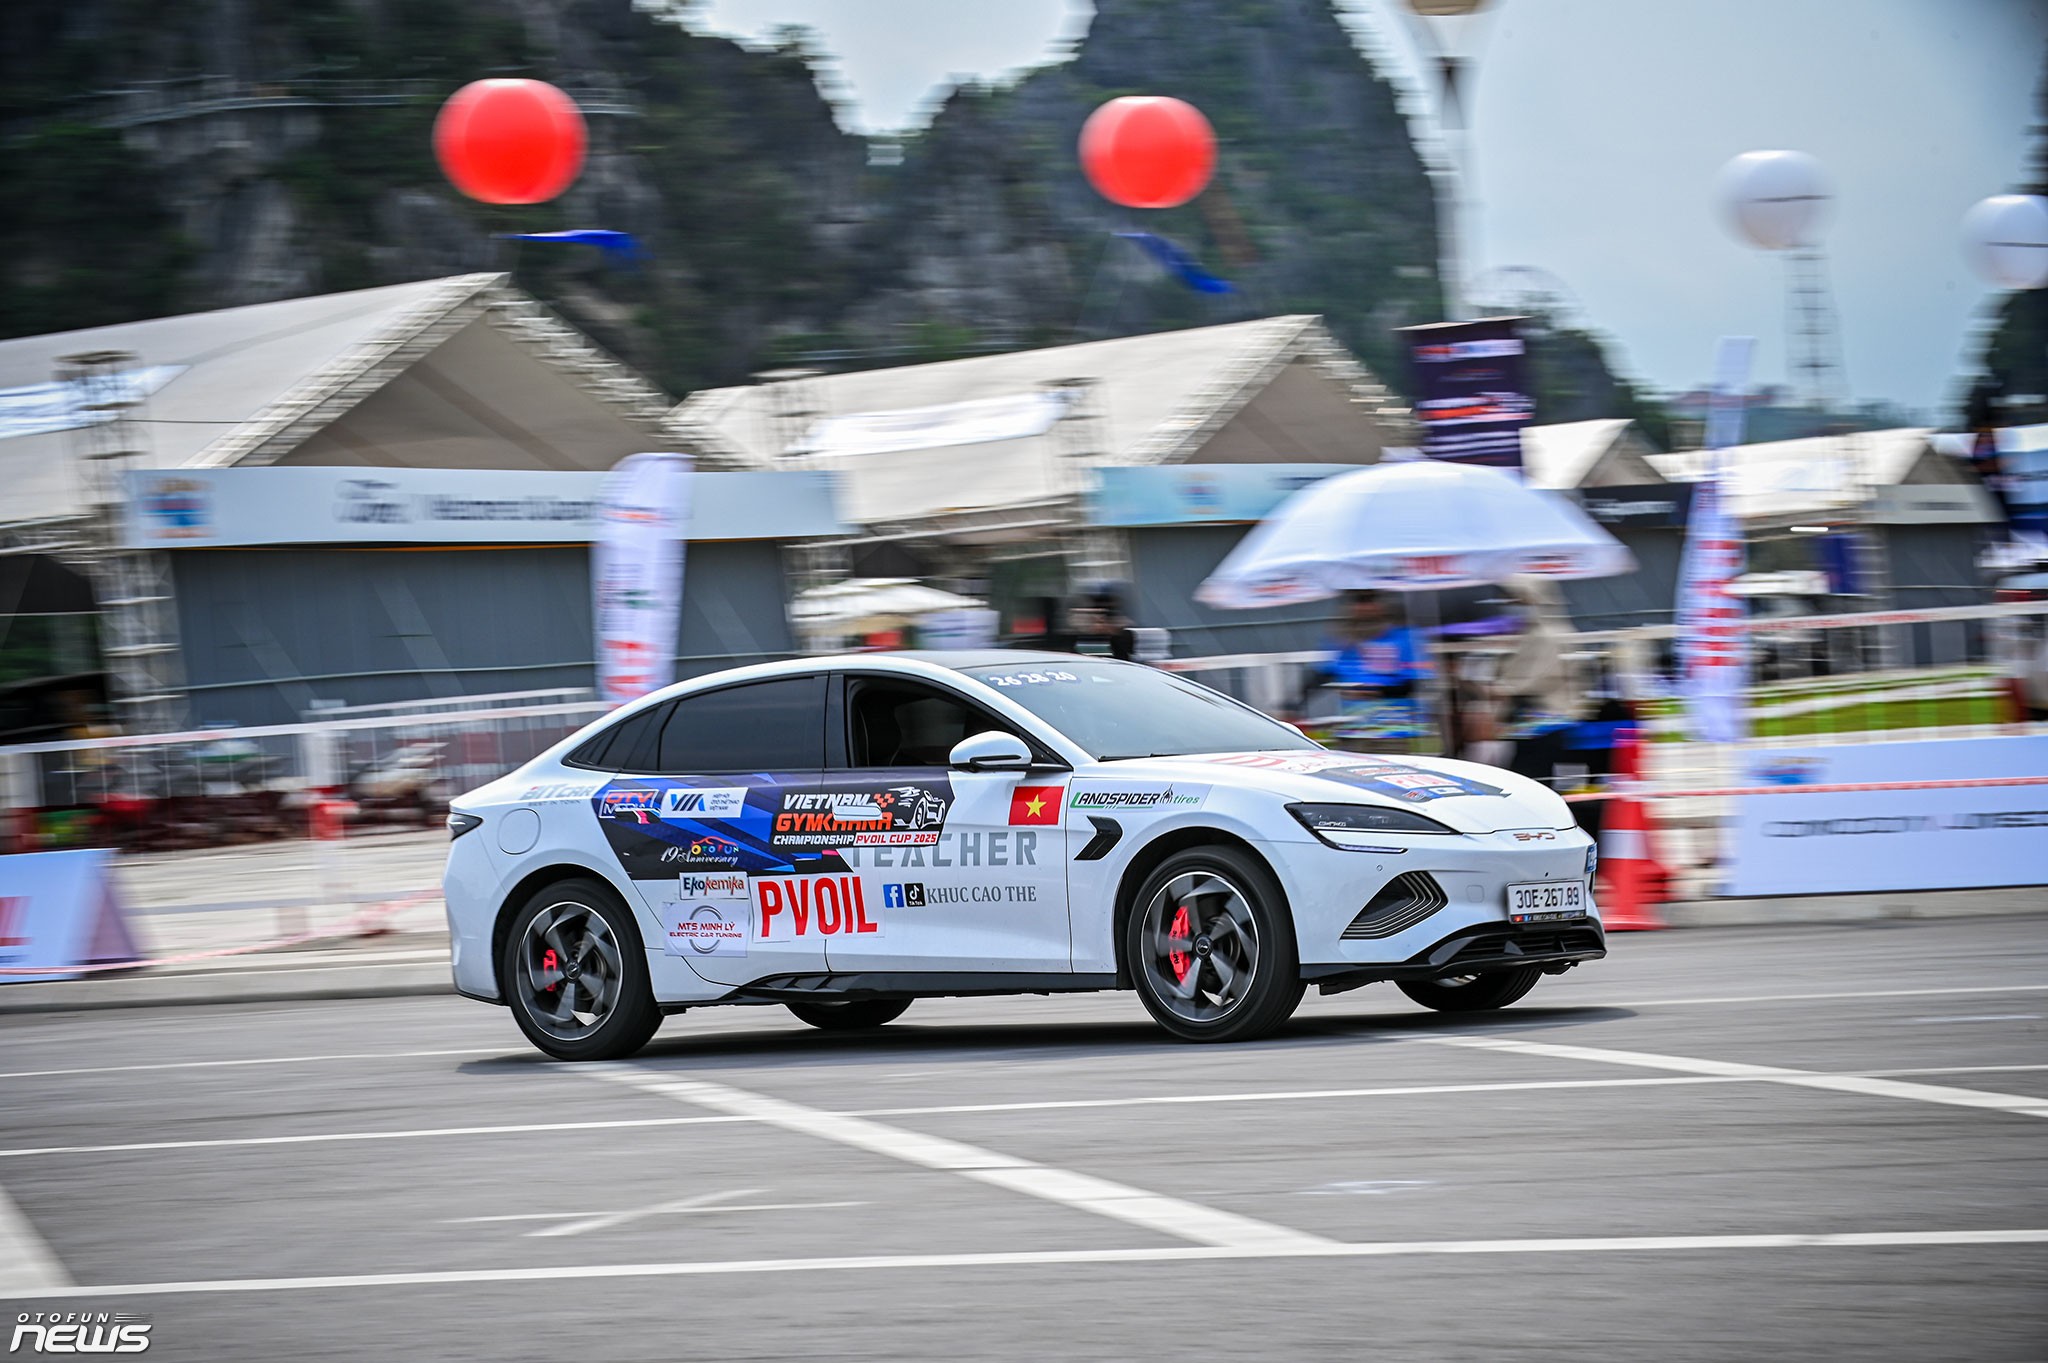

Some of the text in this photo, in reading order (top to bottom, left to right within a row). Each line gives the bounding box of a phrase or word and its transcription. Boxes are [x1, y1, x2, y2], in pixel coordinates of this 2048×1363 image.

[783, 793, 872, 810] VIETNAM
[1070, 791, 1200, 808] LANDSPIDER tires
[773, 833, 937, 845] CHAMPIONSHIP PVOIL CUP 2025
[691, 844, 739, 855] OTOFUN
[677, 849, 738, 868] Anniversary
[683, 876, 745, 896] Ekokemika
[927, 886, 1037, 904] KHUC CAO THE
[758, 876, 878, 938] PVOIL
[678, 923, 698, 931] MTS
[700, 923, 723, 931] MINH
